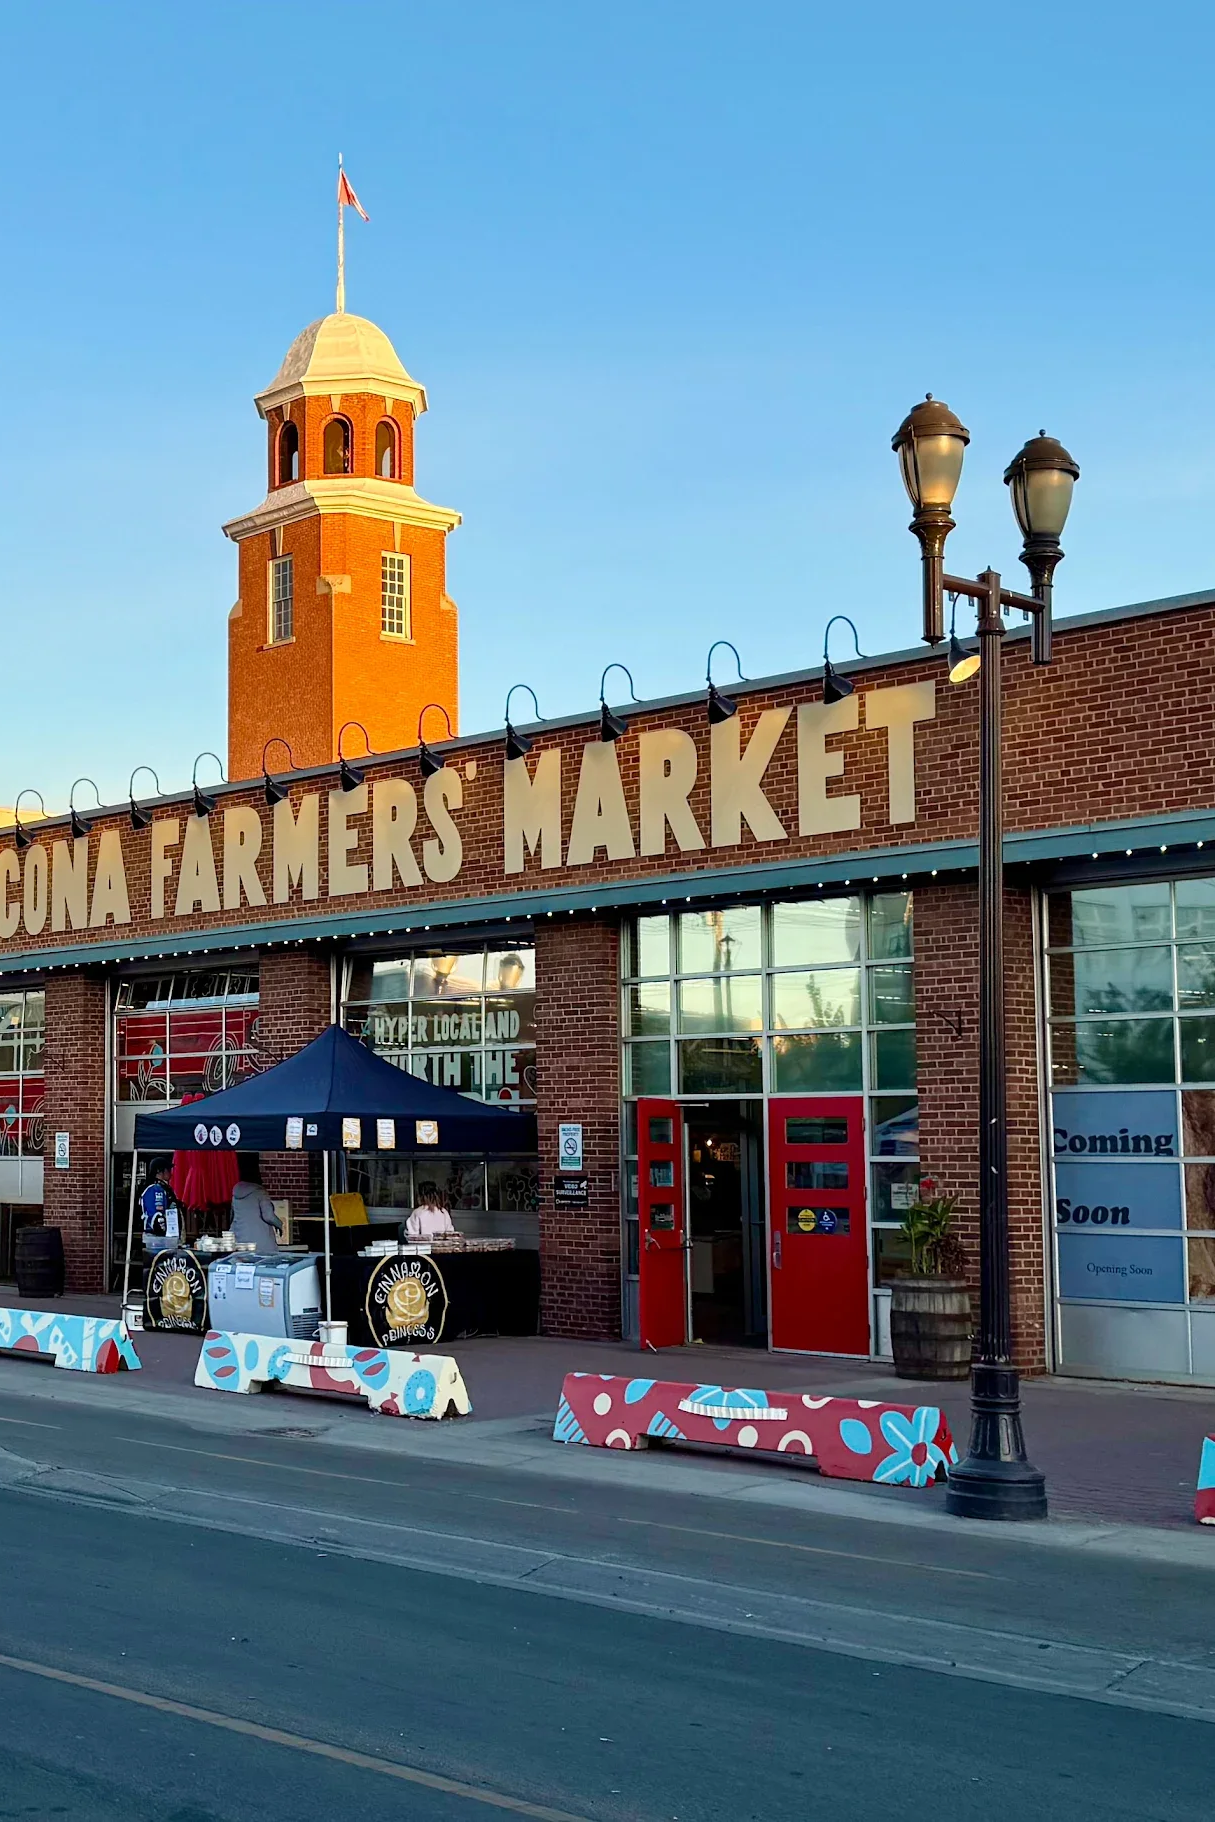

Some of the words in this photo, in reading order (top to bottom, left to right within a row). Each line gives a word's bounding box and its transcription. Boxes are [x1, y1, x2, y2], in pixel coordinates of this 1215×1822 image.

[151, 761, 477, 920] FARMERS'
[504, 680, 936, 874] MARKET
[374, 1015, 428, 1043] HYPER
[433, 1012, 481, 1041] LOCAL
[485, 1010, 521, 1040] AND
[376, 1047, 462, 1086] RTH
[469, 1047, 521, 1085] THE
[1053, 1128, 1174, 1156] Coming
[1056, 1198, 1131, 1225] Soon
[152, 1257, 202, 1294] CINNAMON
[374, 1261, 439, 1304] CINNAMON
[1086, 1262, 1128, 1277] Opening
[1129, 1264, 1153, 1275] Soon
[381, 1323, 436, 1346] PRINCESS
